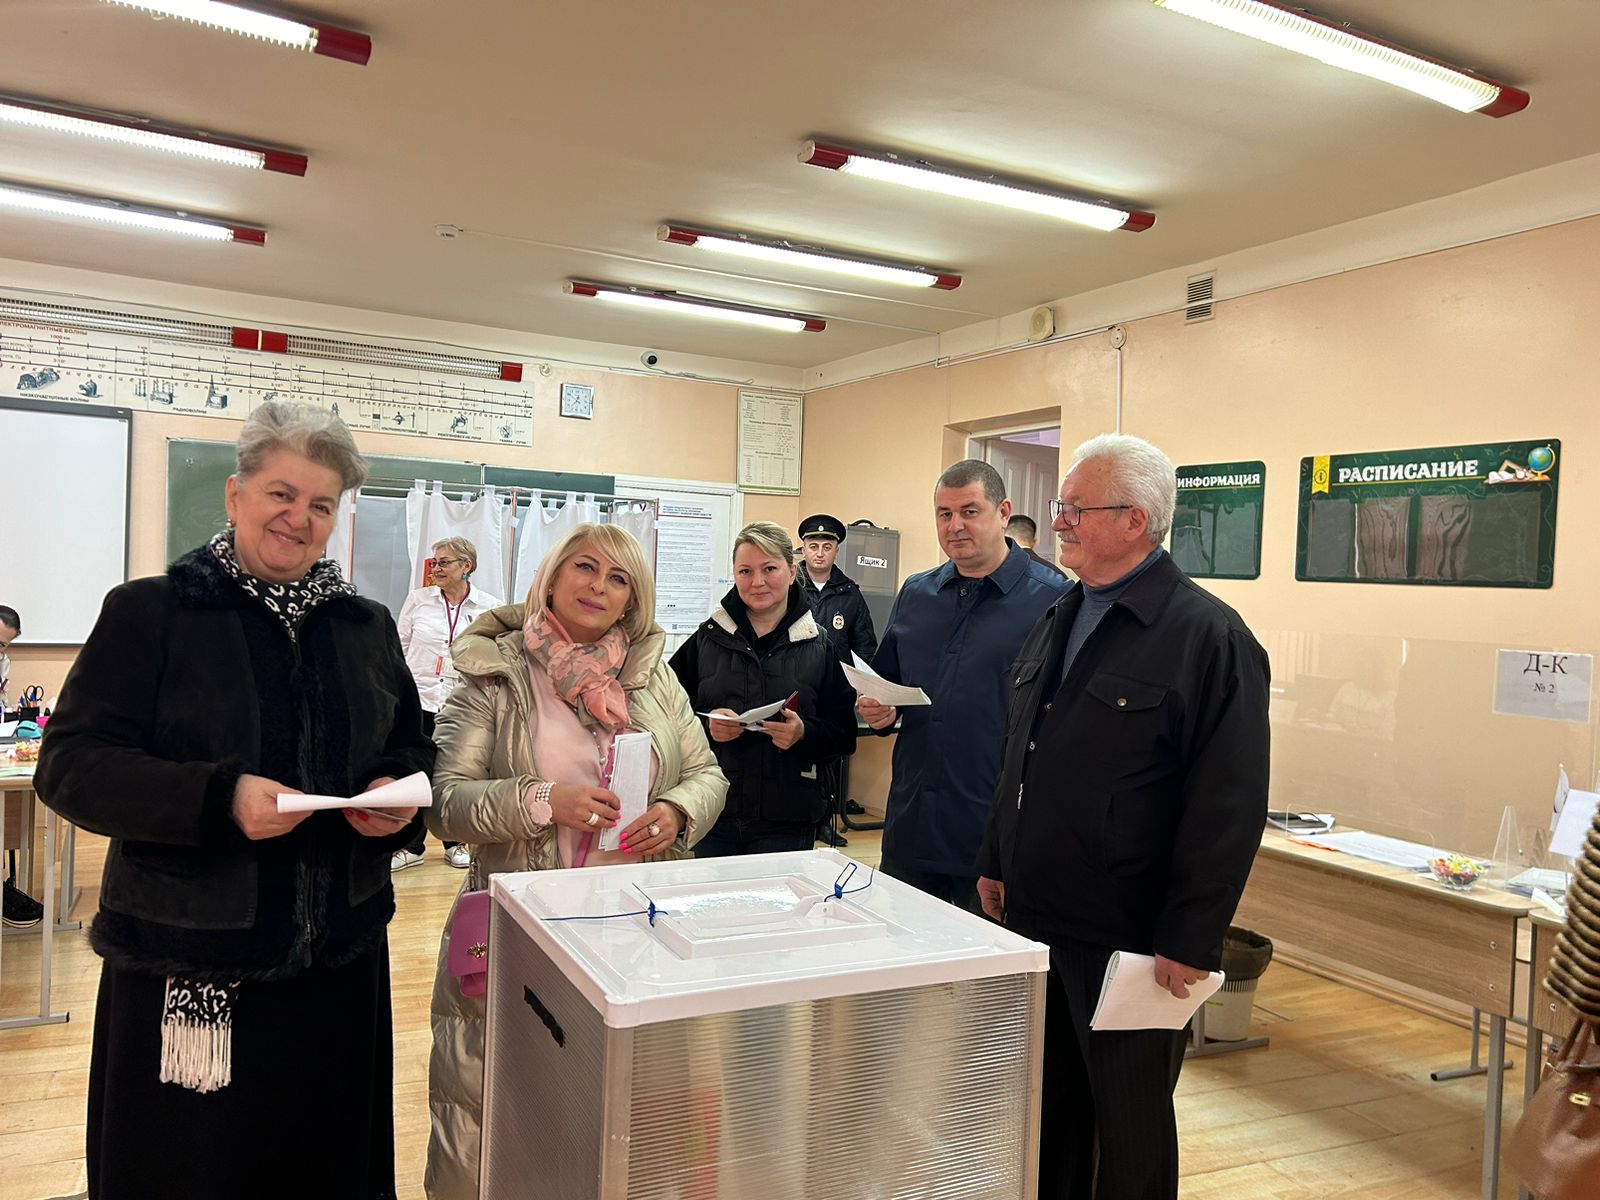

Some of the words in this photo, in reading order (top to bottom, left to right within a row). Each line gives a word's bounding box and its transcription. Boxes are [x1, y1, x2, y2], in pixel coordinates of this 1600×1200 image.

[1338, 460, 1479, 483] РАСПИСАНИЕ
[1177, 473, 1261, 488] ИНФОРМАЦИЯ
[860, 556, 880, 565] Ящик
[881, 558, 886, 566] 2
[1523, 653, 1568, 676] Д-К
[1548, 684, 1555, 693] 2
